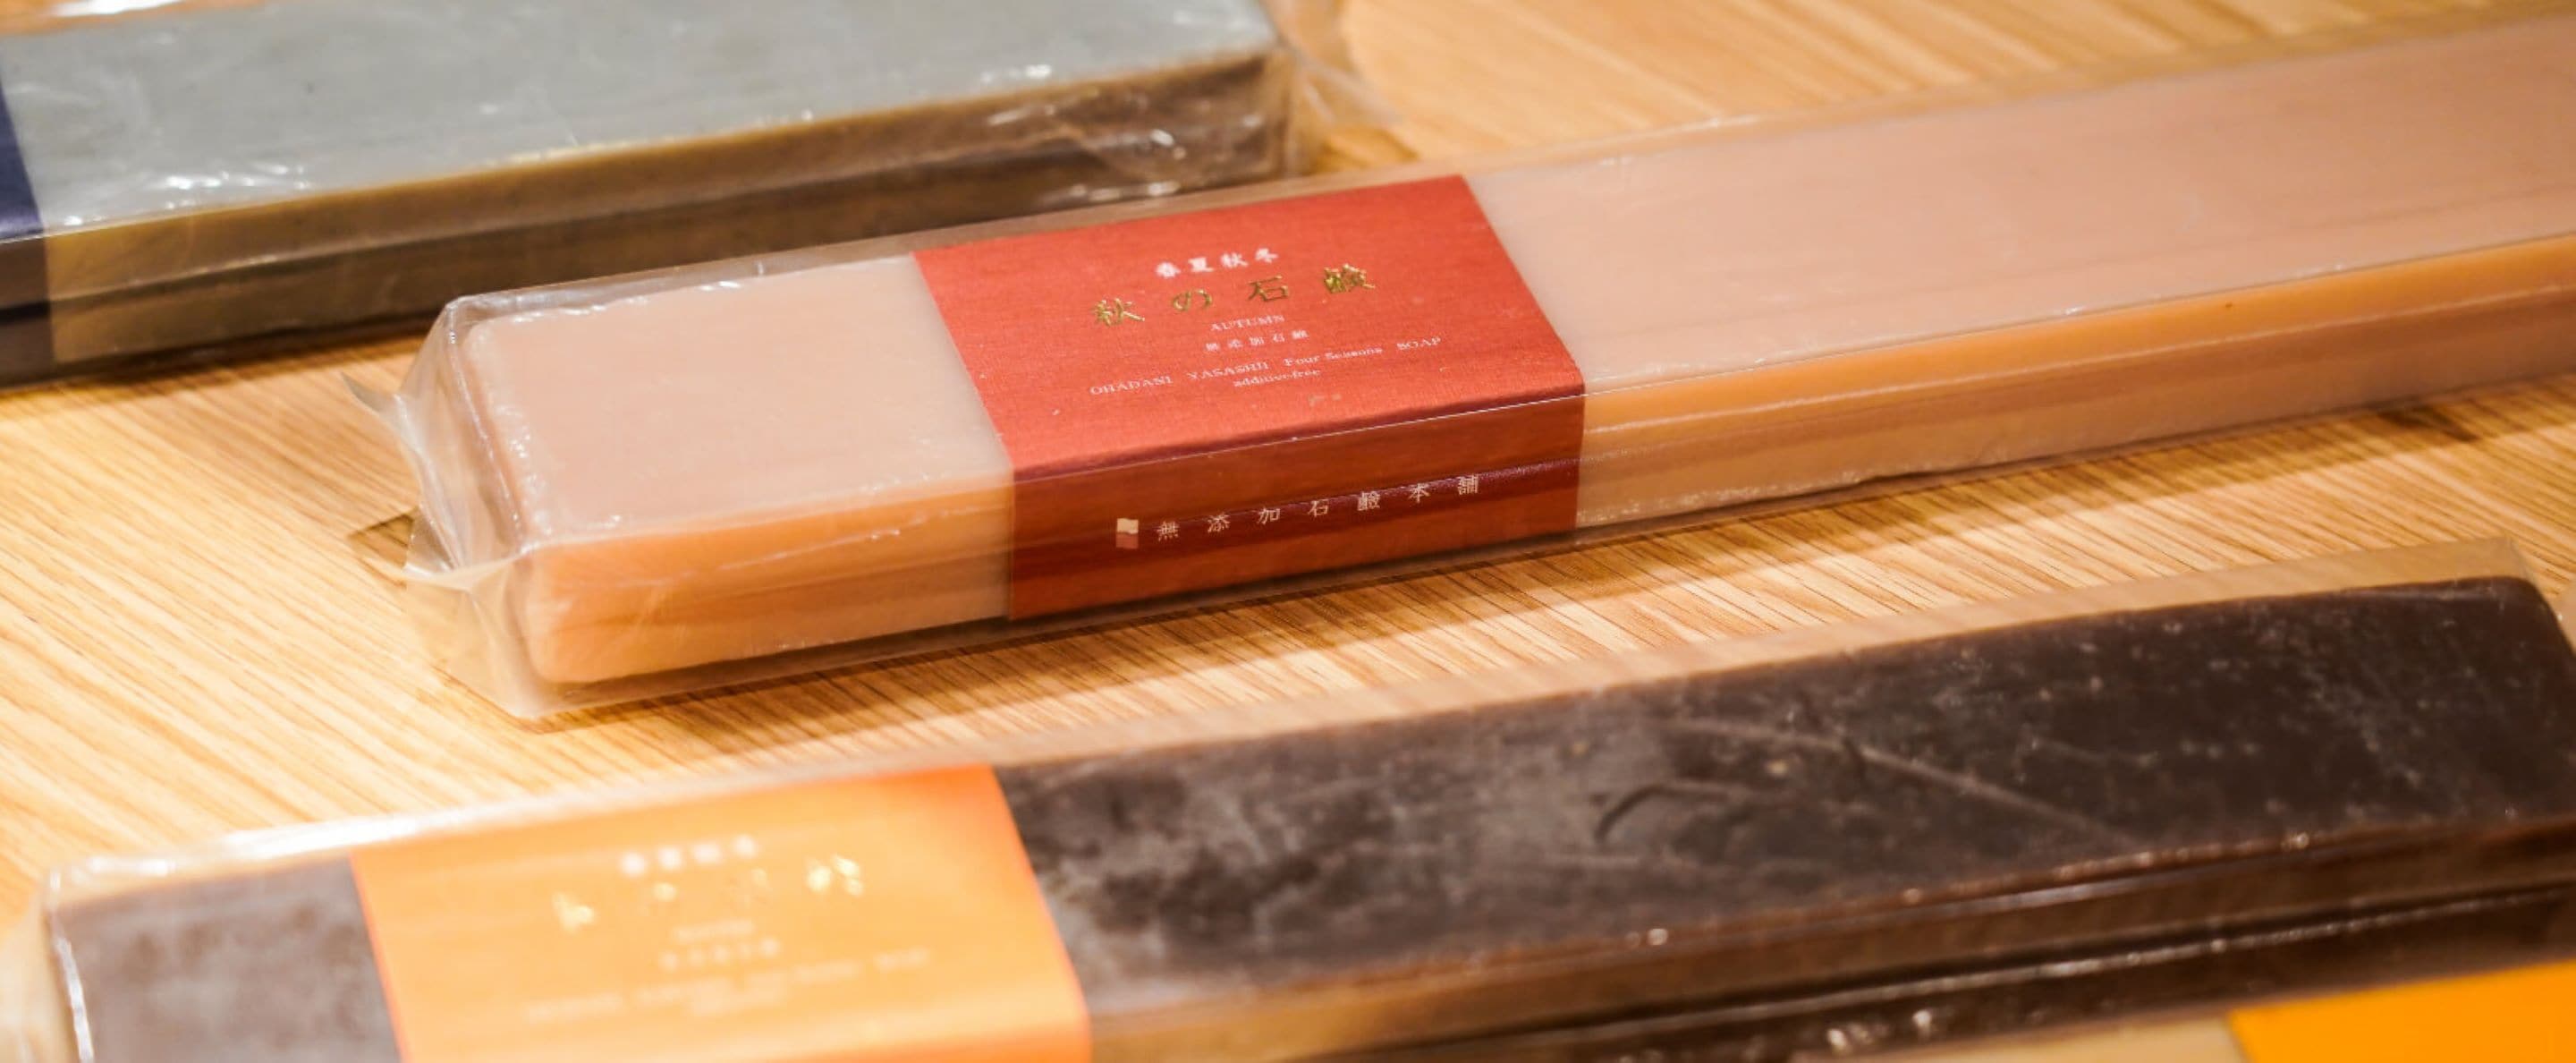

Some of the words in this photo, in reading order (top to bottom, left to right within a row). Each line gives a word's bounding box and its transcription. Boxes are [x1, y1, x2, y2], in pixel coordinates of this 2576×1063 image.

[1210, 315, 1285, 331] AUTUMN
[1283, 354, 1321, 367] Four
[1325, 346, 1383, 362] Seasons
[1396, 336, 1442, 352] SOAP
